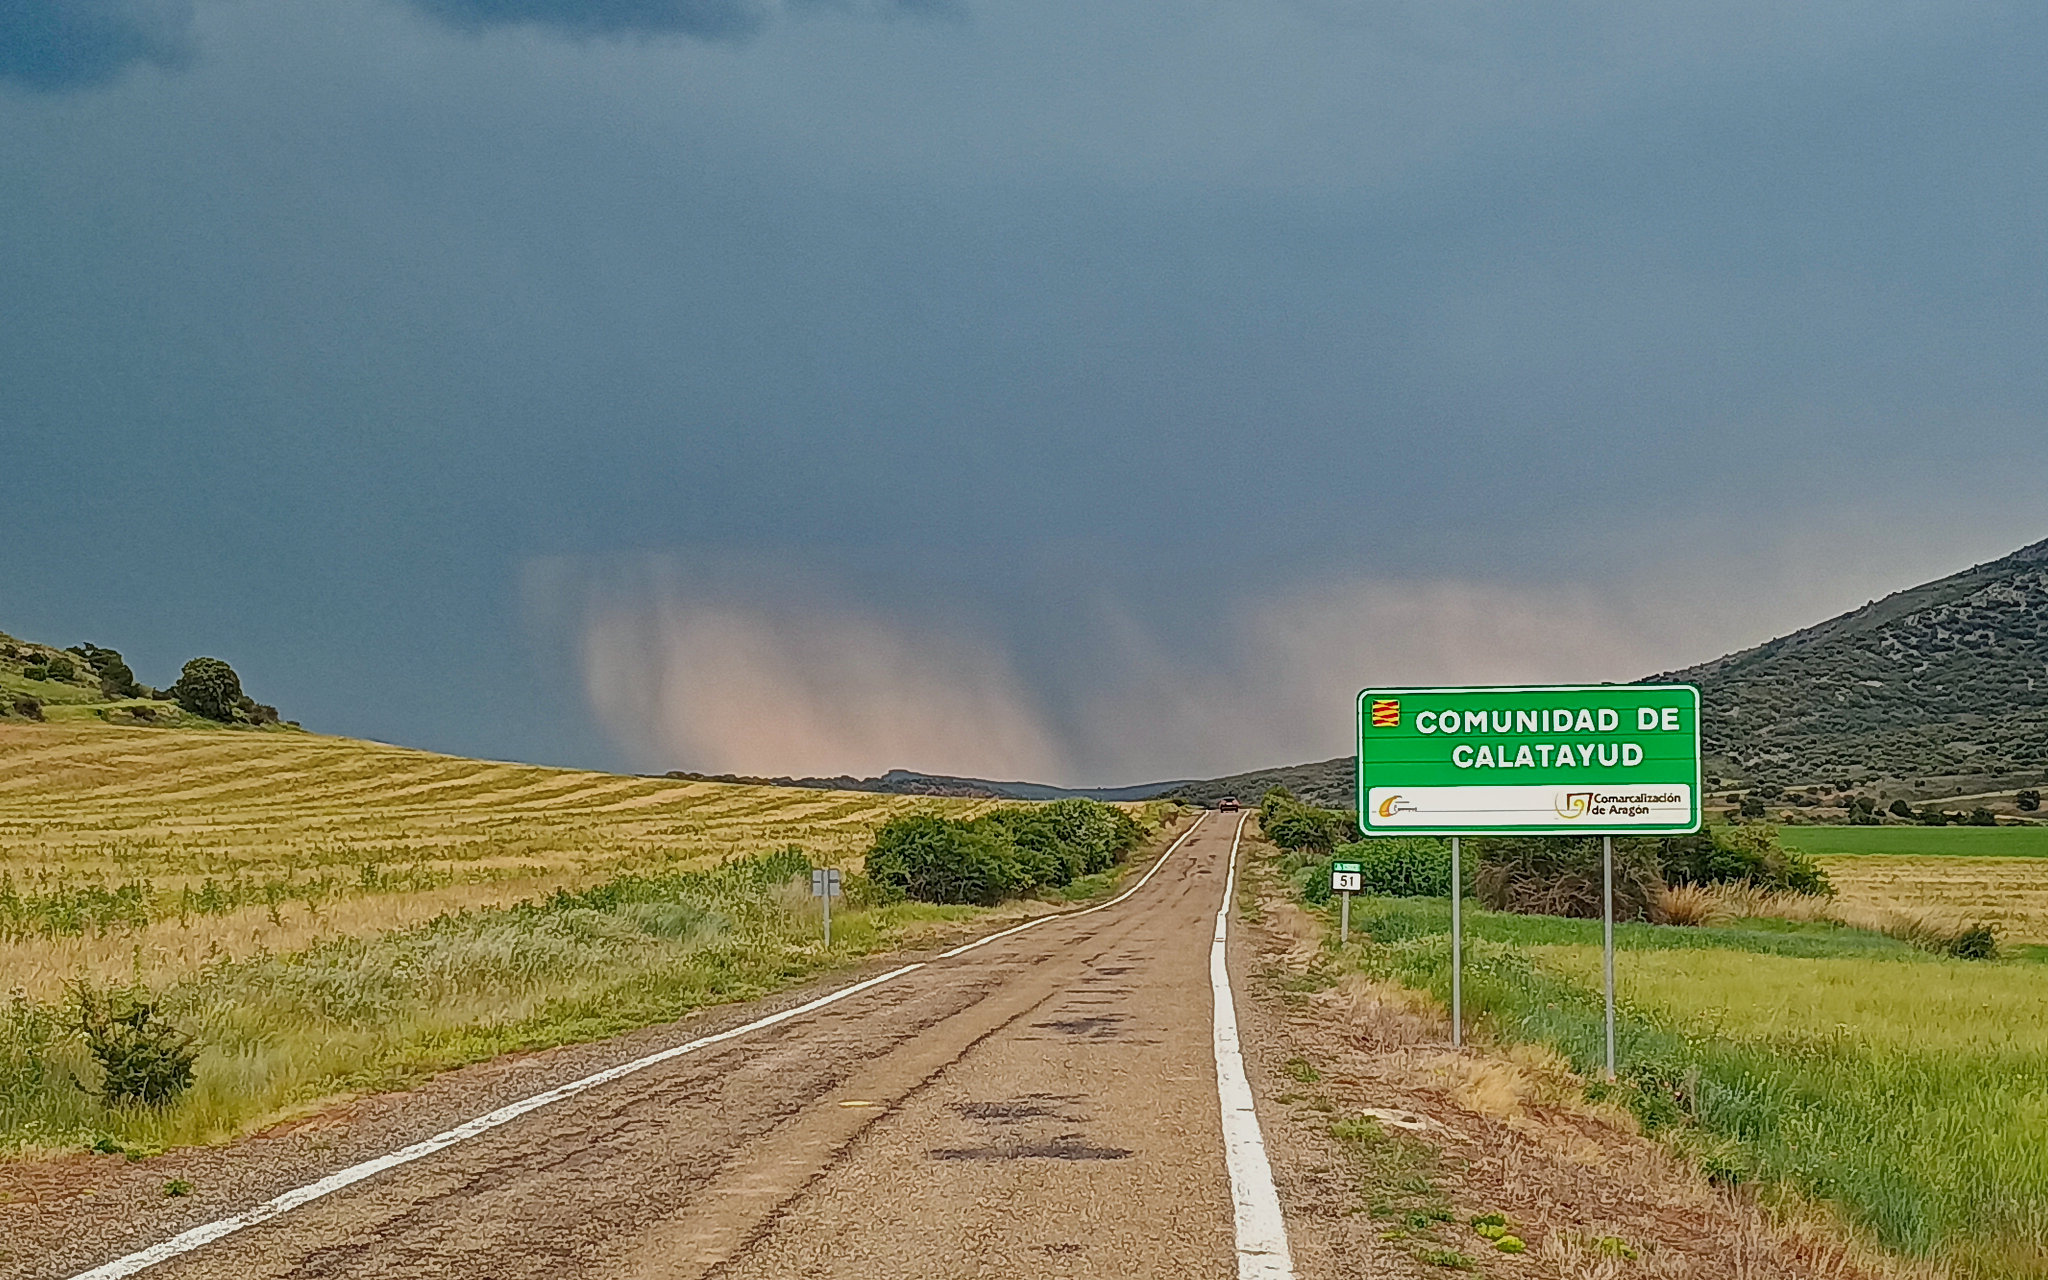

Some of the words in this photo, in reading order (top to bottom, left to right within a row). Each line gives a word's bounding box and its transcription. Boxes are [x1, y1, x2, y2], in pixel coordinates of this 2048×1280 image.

[1415, 708, 1620, 734] COMUNIDAD
[1637, 707, 1680, 731] DE
[1452, 743, 1644, 768] CALATAYUD
[1593, 792, 1681, 804] Comarcalización
[1592, 805, 1606, 815] de
[1609, 804, 1650, 817] Aragón
[1340, 875, 1354, 887] 51
